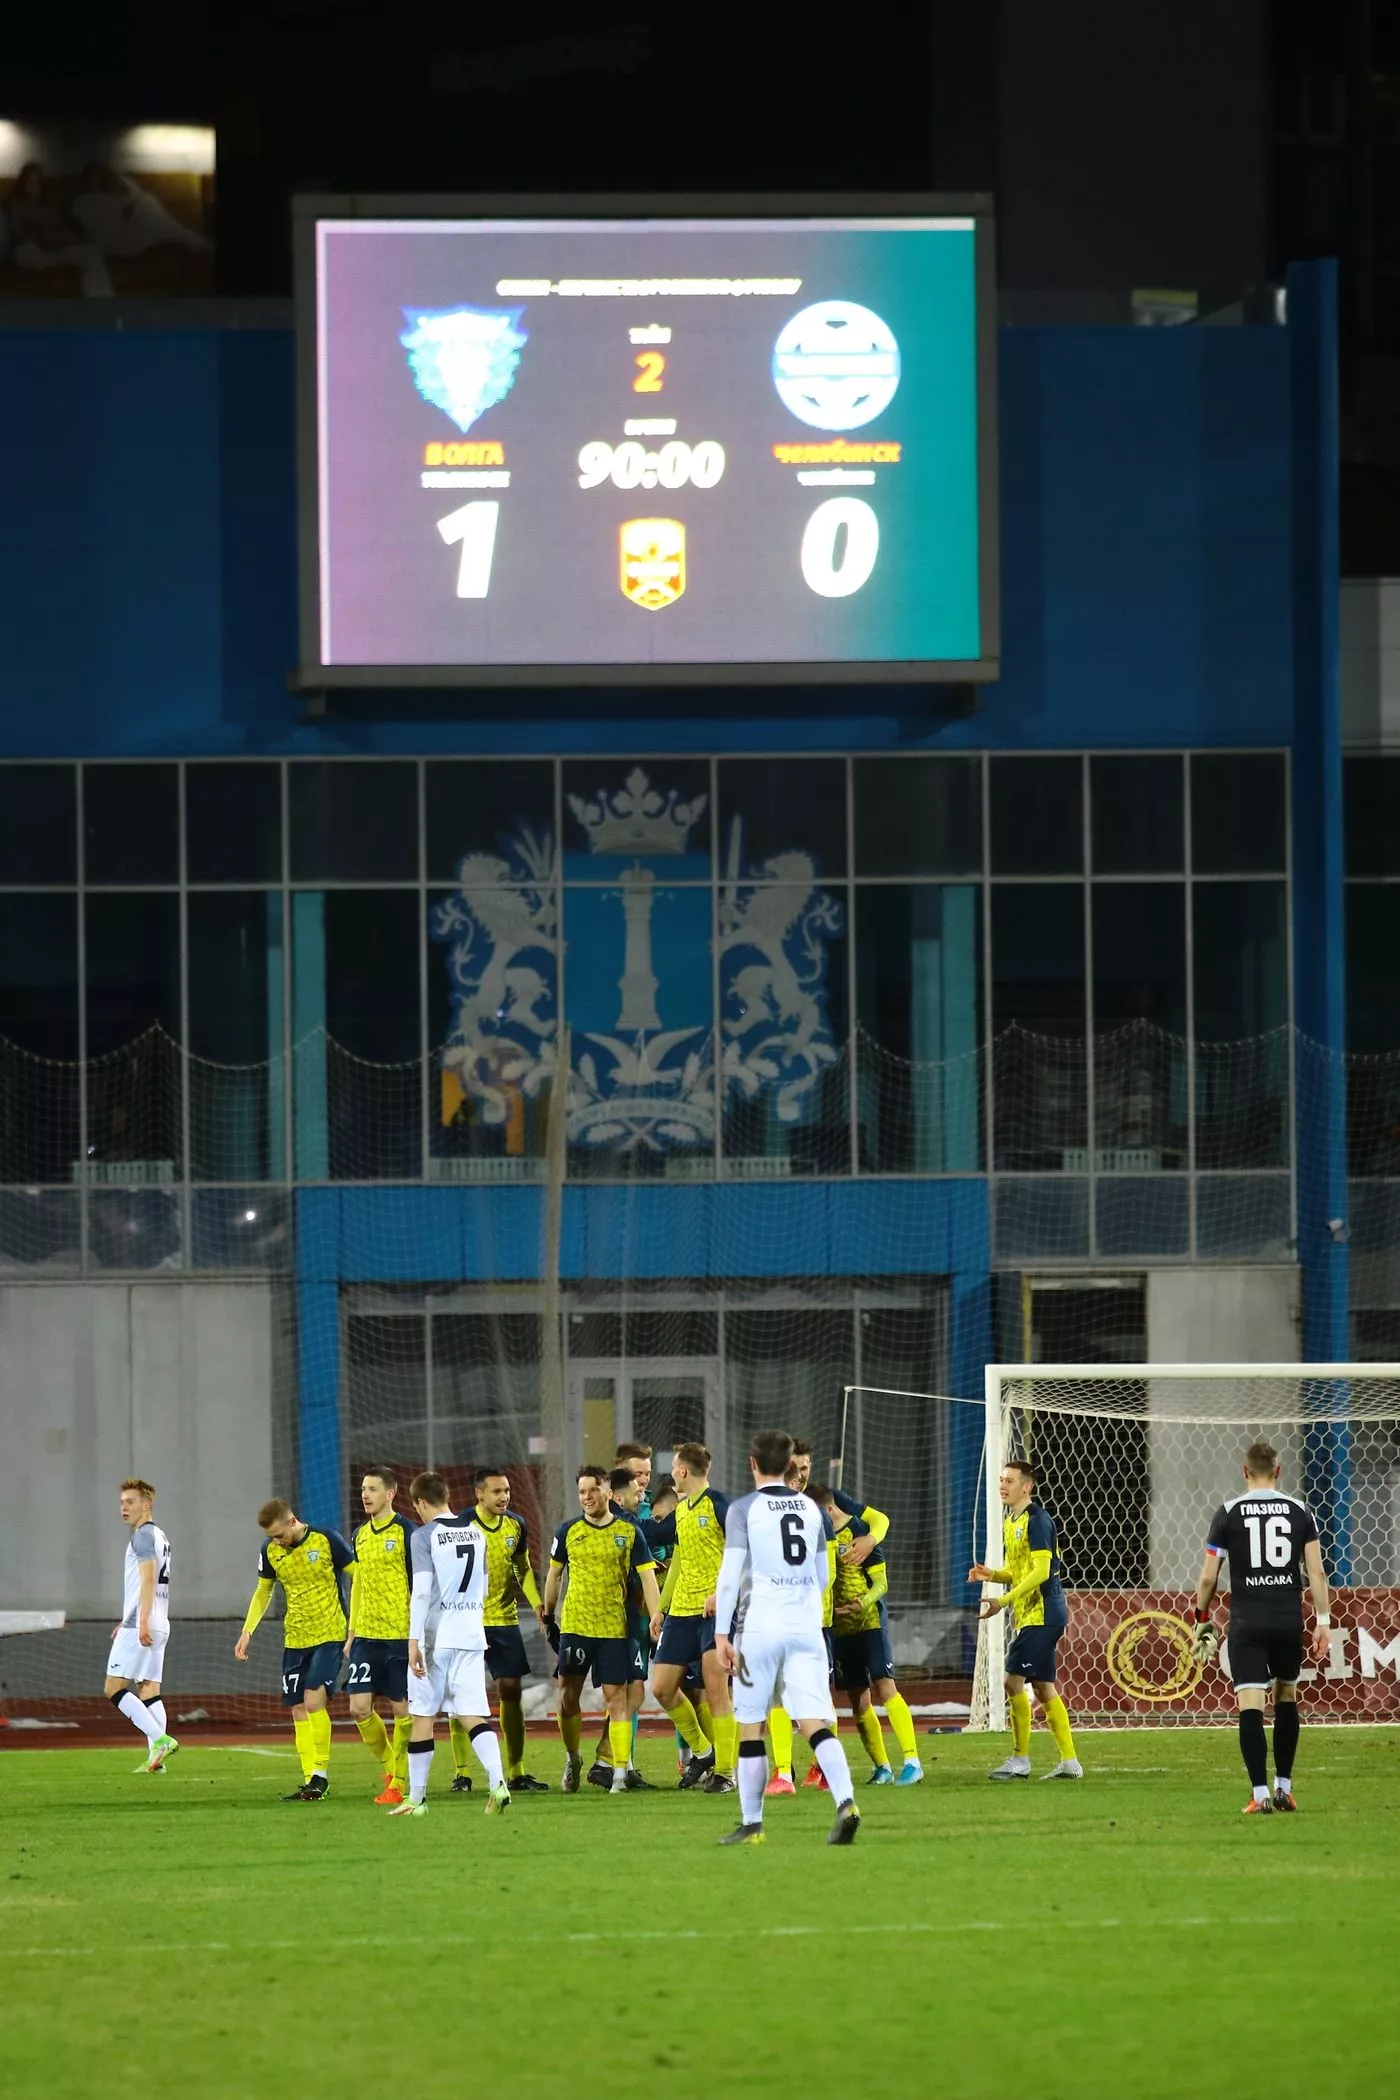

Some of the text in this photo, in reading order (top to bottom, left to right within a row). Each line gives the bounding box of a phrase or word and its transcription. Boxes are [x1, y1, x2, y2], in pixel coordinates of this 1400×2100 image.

[633, 350, 666, 393] 2
[424, 441, 505, 467] ВОЛГА
[578, 441, 725, 489] 90:00
[437, 501, 499, 598] 1
[801, 497, 879, 598] 0
[767, 1499, 807, 1512] САРАЕВ
[1240, 1502, 1290, 1516] ГЛАЗКОВ
[780, 1513, 807, 1567] 6
[1243, 1515, 1292, 1569] 16
[456, 1543, 475, 1593] 7
[769, 1575, 815, 1587] NIAGARA
[1245, 1575, 1293, 1587] NIAGARA
[440, 1601, 485, 1611] NIAGARA
[564, 1646, 586, 1667] 19
[348, 1662, 372, 1684] 22
